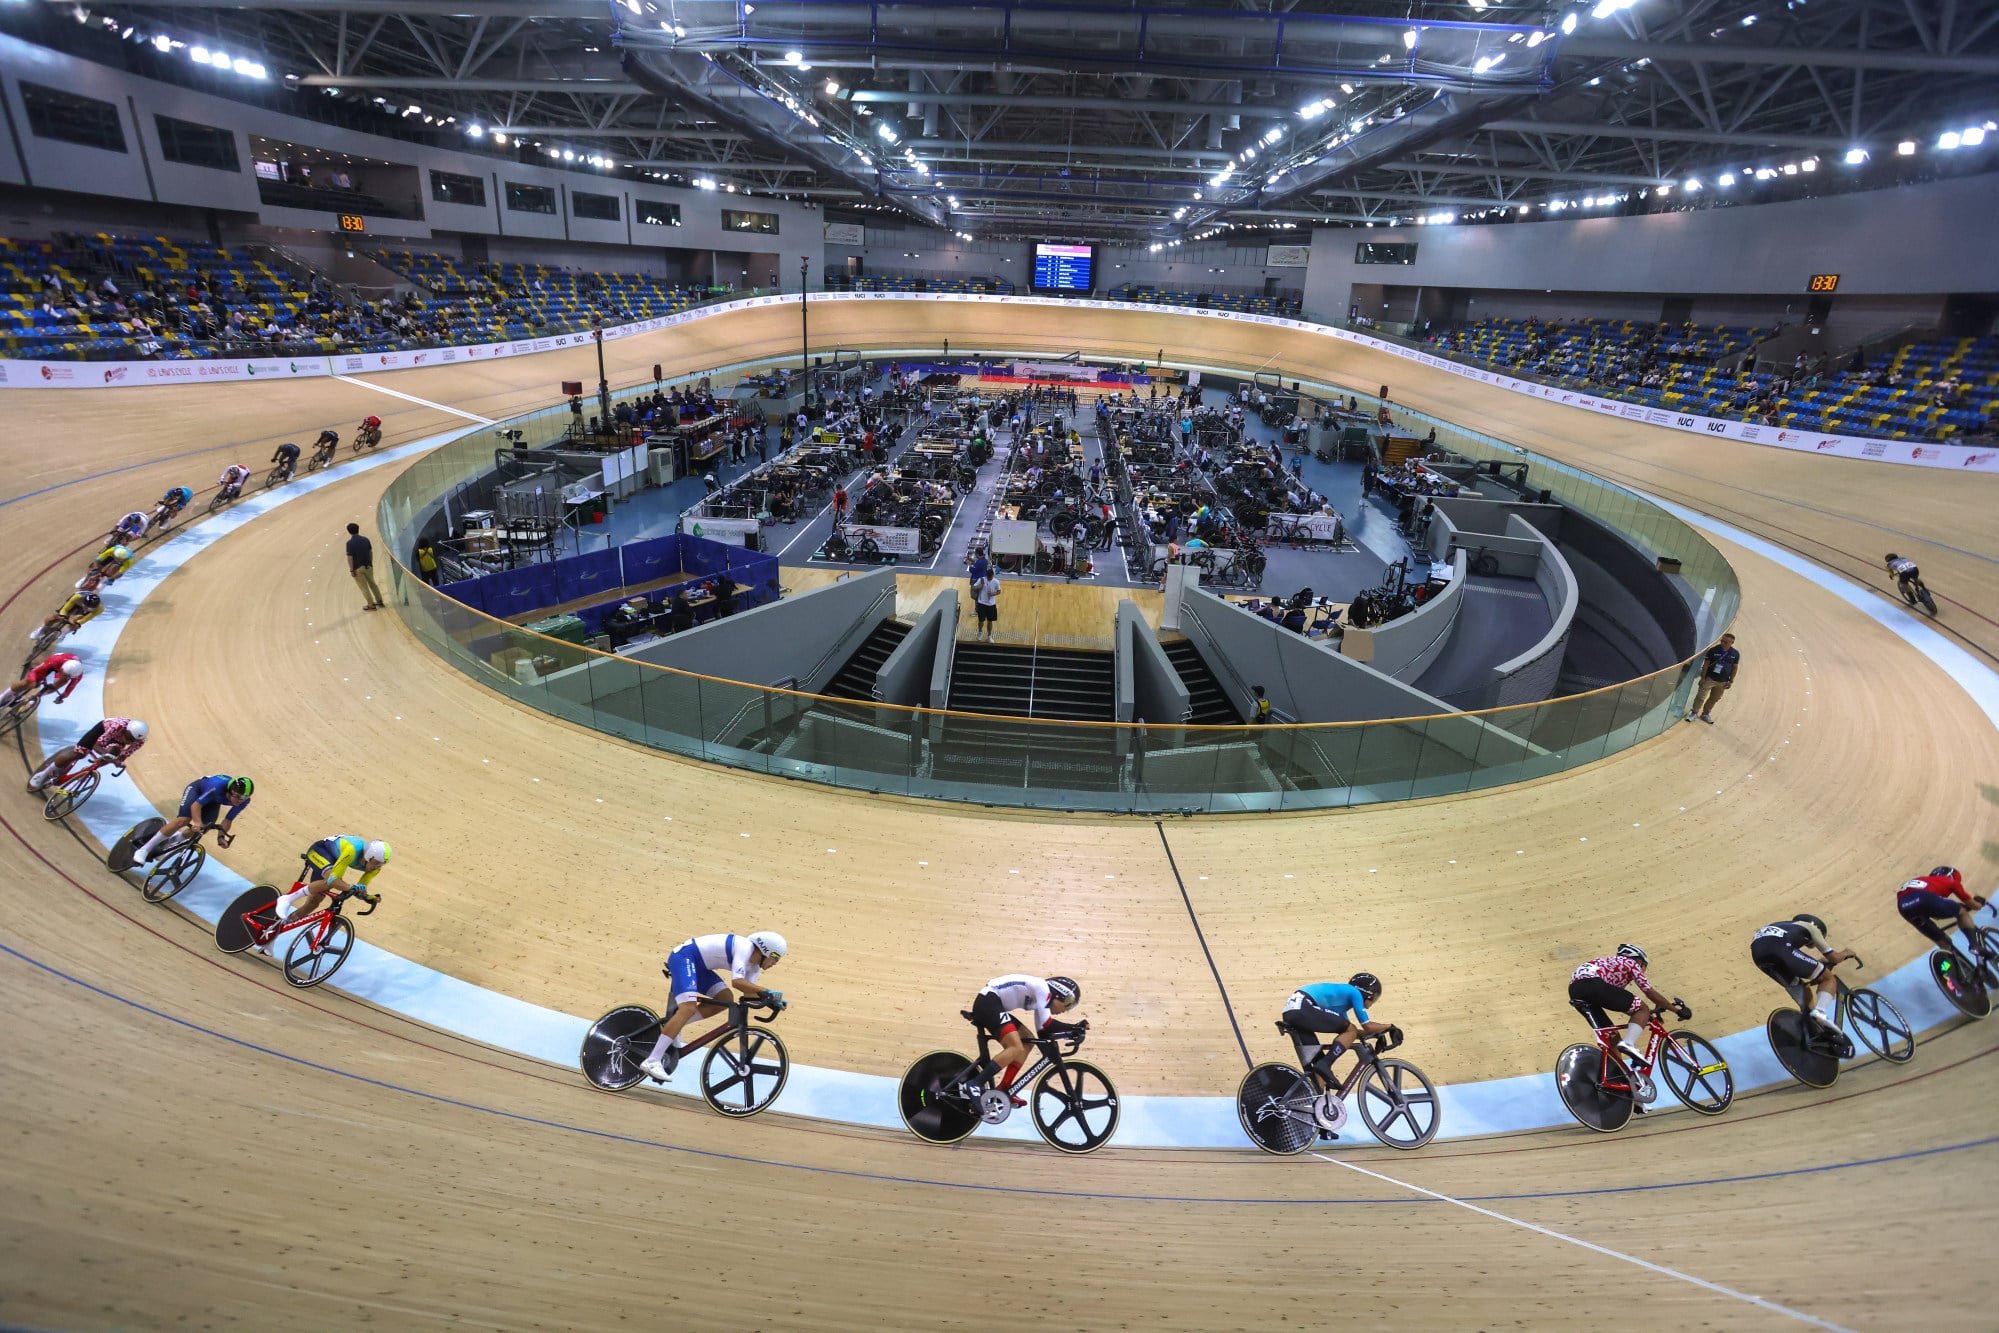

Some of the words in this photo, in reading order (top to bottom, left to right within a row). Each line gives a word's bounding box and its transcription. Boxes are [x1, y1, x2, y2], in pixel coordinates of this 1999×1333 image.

[342, 215, 363, 230] 13:30
[1811, 275, 1838, 290] 13:30
[1680, 417, 1695, 428] UCI
[1710, 422, 1726, 433] UCI
[1311, 523, 1332, 532] CYCLE
[757, 937, 769, 953] KASK
[1008, 1056, 1050, 1096] BRIDGESTONE
